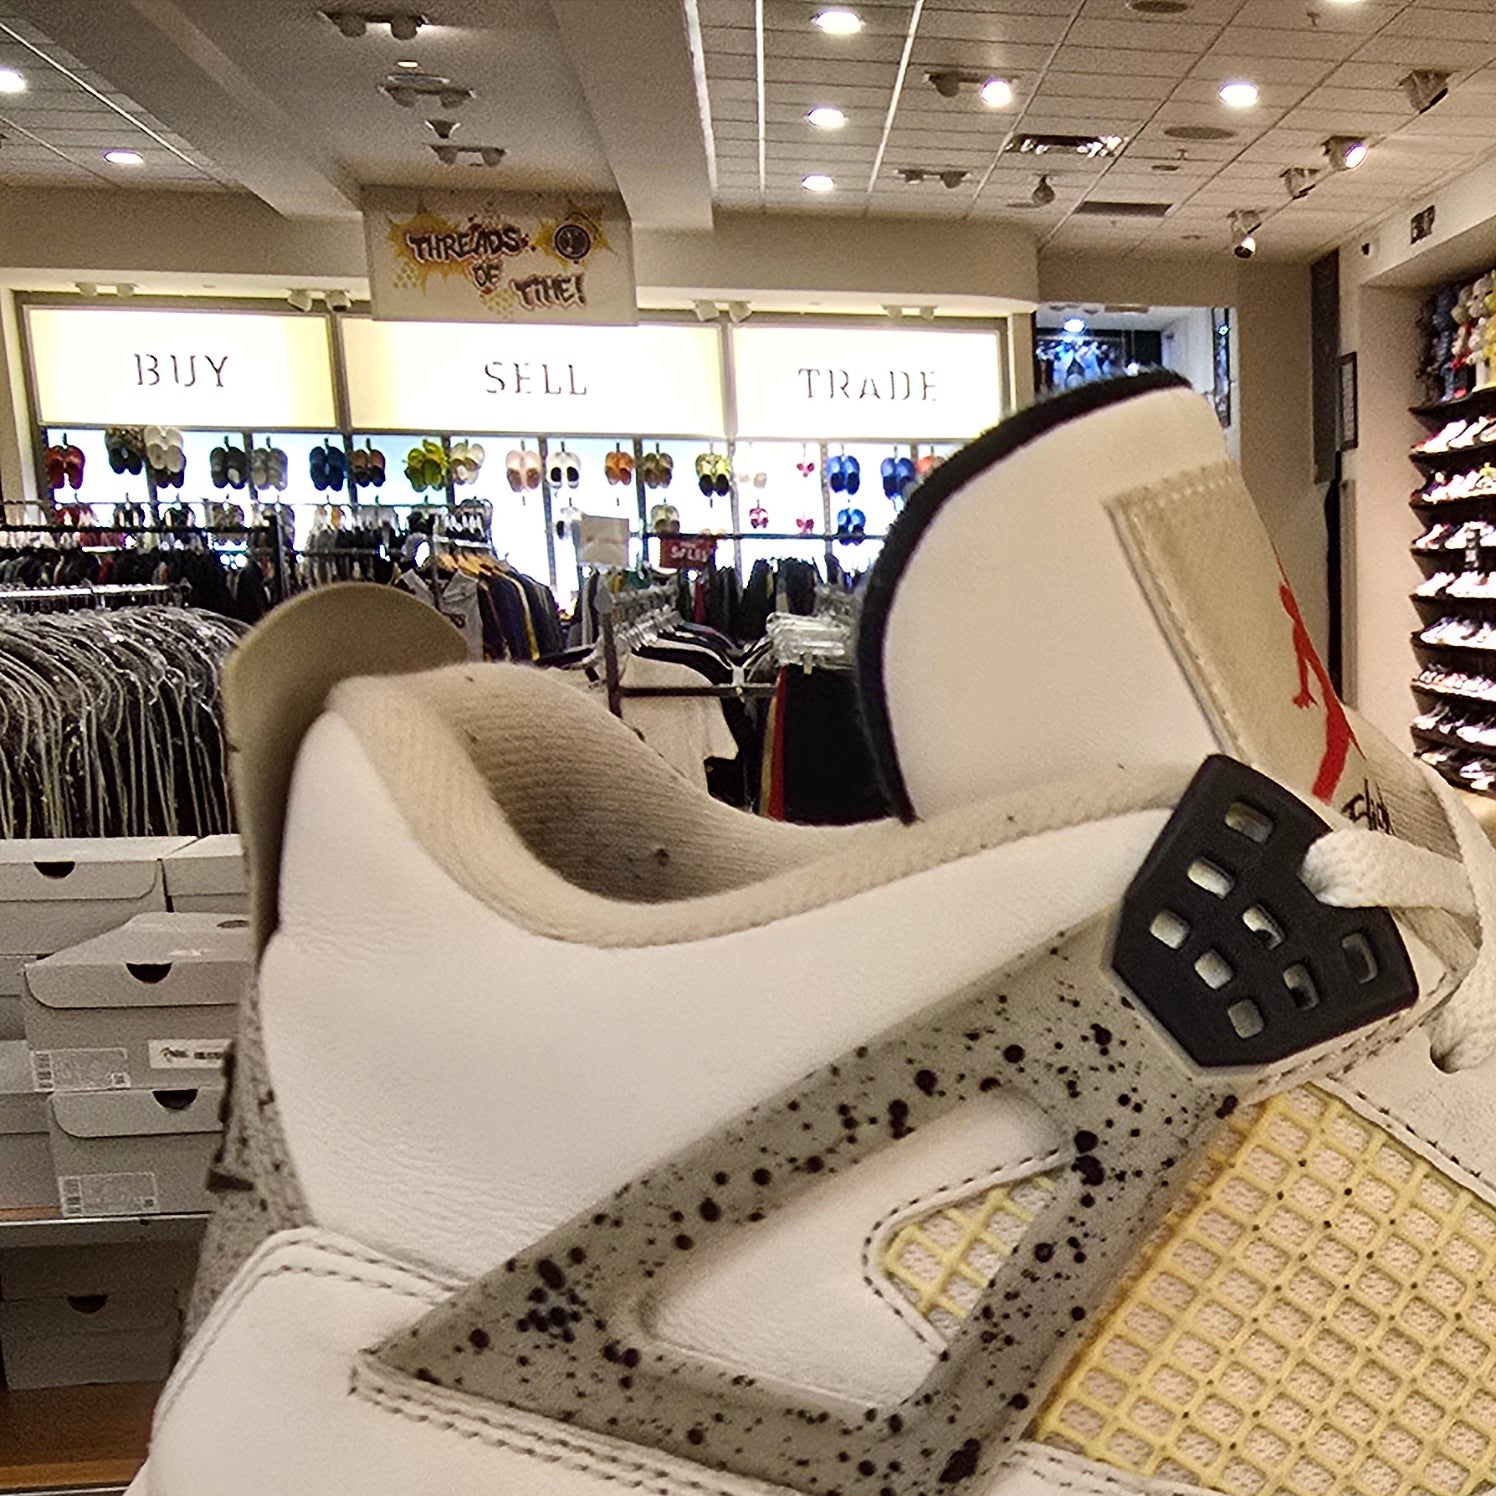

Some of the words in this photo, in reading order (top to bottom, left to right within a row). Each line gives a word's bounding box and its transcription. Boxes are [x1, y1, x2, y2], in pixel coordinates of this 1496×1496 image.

[406, 225, 522, 263] THREADS
[134, 353, 229, 388] BUY
[484, 361, 588, 396] SELL
[798, 367, 937, 402] TRADE
